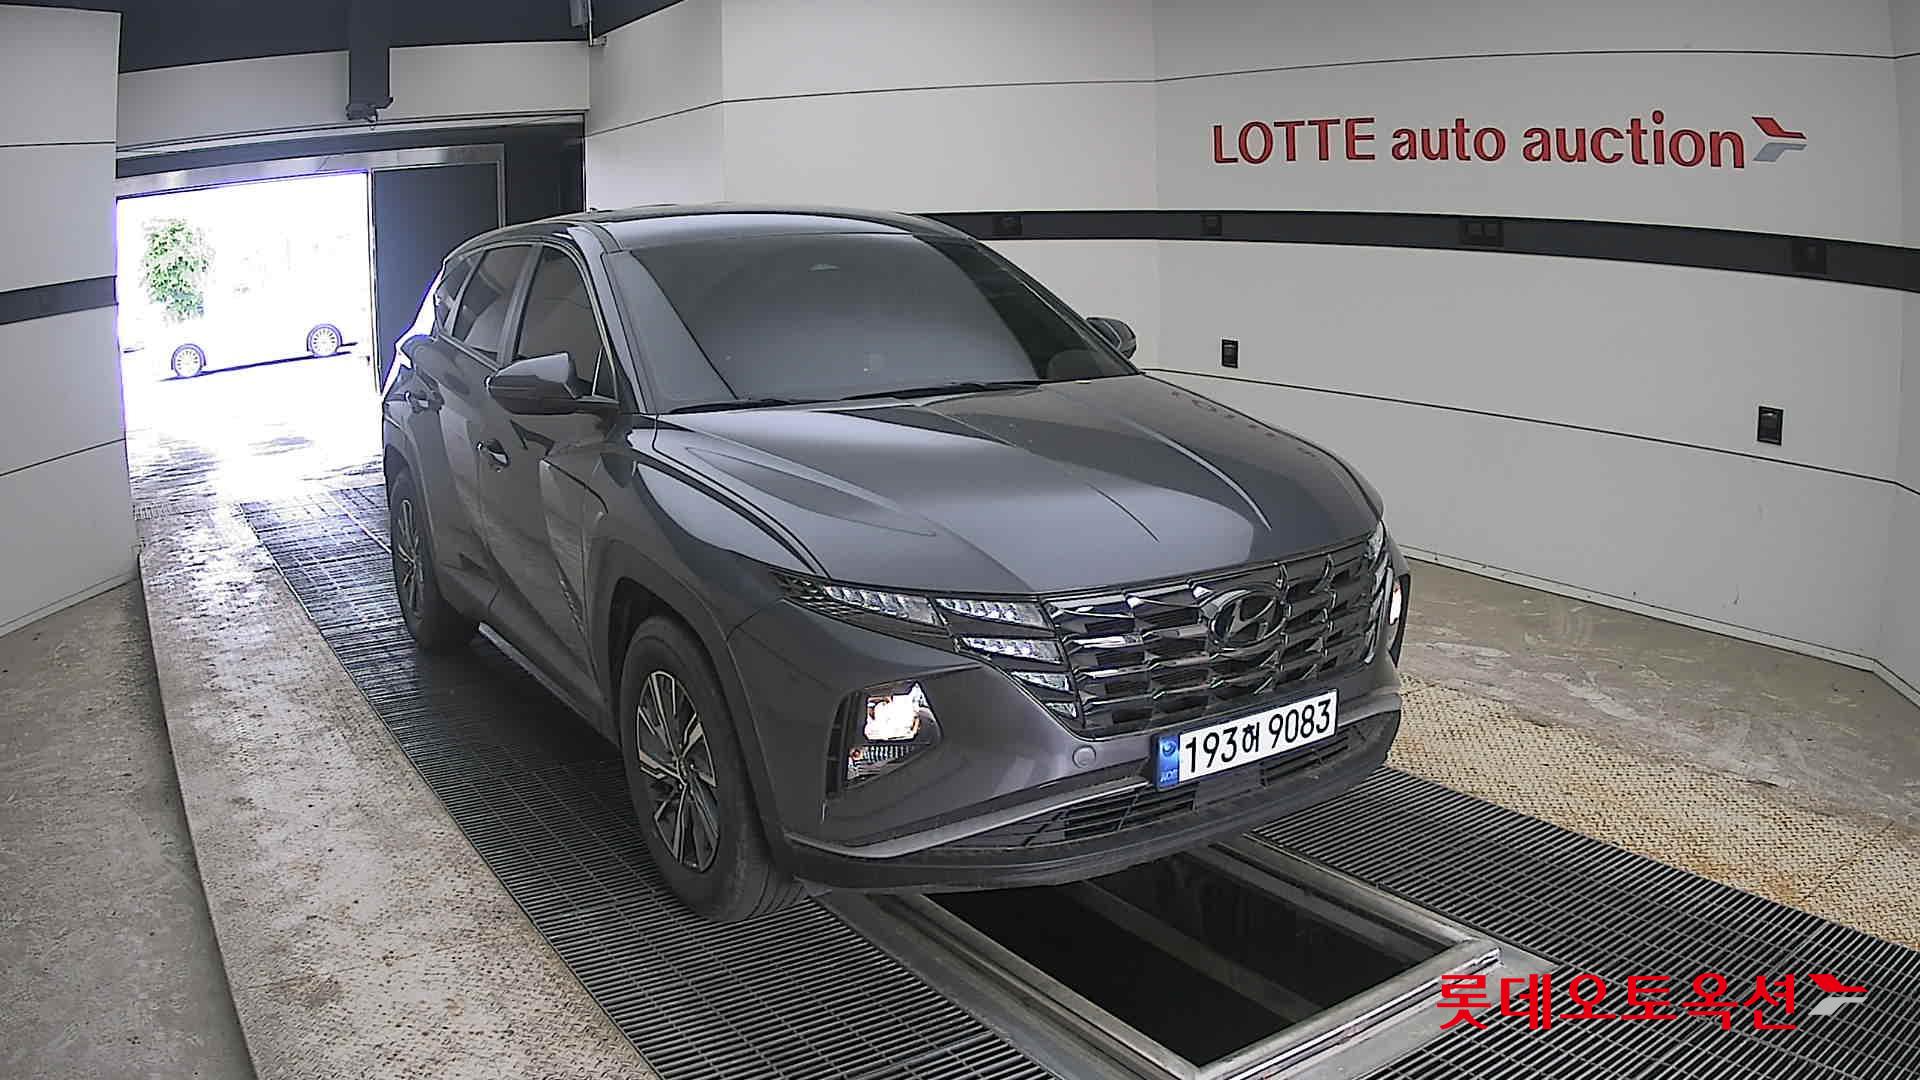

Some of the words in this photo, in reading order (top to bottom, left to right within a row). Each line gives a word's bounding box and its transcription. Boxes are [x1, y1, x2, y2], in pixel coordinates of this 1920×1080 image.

[1212, 117, 1376, 164] LOTTE
[1391, 118, 1507, 162] auto
[1522, 110, 1746, 169] auction
[1185, 721, 1261, 773] 193허
[1268, 699, 1331, 749] 9083
